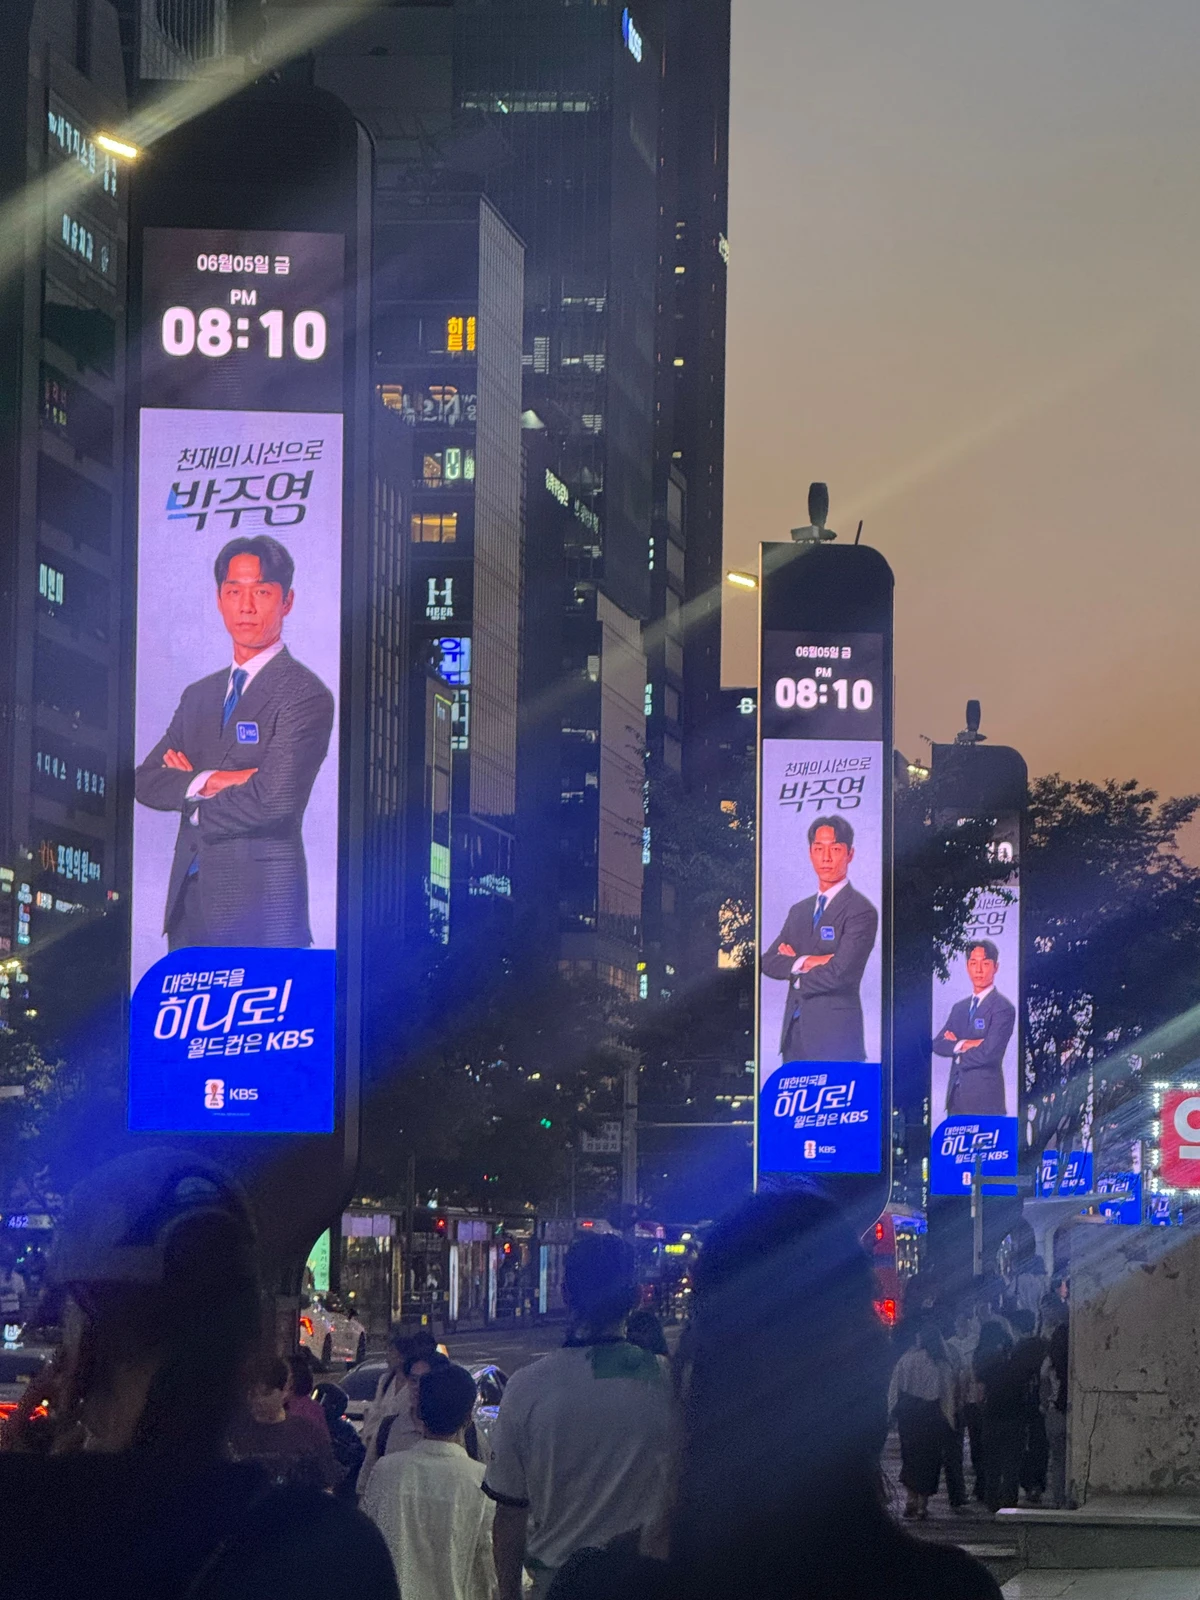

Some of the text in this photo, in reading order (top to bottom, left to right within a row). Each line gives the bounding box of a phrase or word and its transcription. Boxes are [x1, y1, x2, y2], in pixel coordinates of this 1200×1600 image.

[196, 253, 291, 274] 06월05일 금
[230, 289, 256, 306] PM
[162, 305, 327, 361] 08:10
[176, 439, 325, 472] 천재의 시선으로
[165, 469, 315, 532] 박주영
[795, 645, 851, 659] 06월05일 금
[815, 666, 833, 678] PM
[774, 677, 873, 711] 08:10
[785, 756, 872, 777] 천재의 시선으로
[779, 775, 866, 814] 박주영
[976, 896, 1008, 909] 시선으
[966, 910, 1008, 936] 주영
[161, 967, 246, 995] 대한민국을
[187, 1028, 315, 1060] 월드컵은 KBS
[778, 1073, 828, 1090] 대한민국을
[229, 1087, 259, 1101] KBS
[793, 1109, 869, 1129] 월드컵은 KBS
[818, 1145, 837, 1154] KBS
[987, 1149, 1009, 1161] KBS
